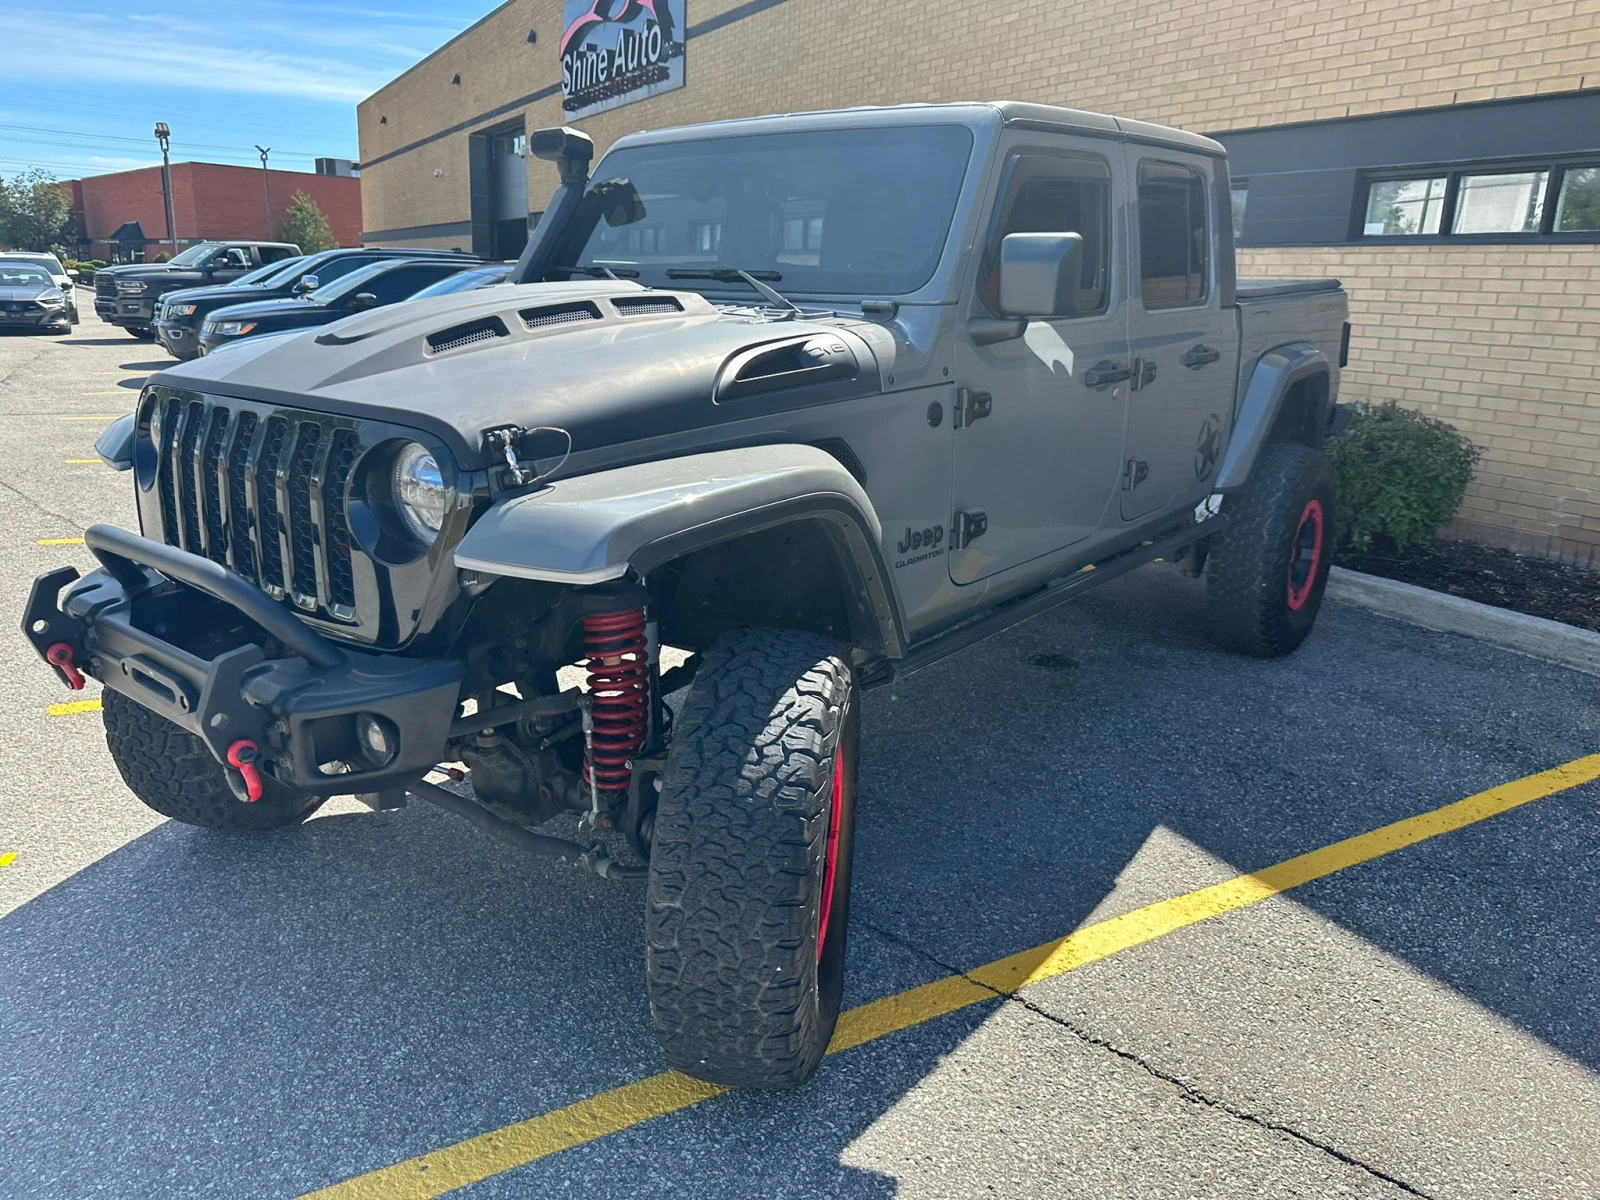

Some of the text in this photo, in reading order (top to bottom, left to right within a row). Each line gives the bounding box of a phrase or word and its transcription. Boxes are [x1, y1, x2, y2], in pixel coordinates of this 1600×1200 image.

[562, 43, 608, 96] Shine
[612, 21, 661, 77] Auto
[897, 525, 943, 554] Jeep
[895, 549, 944, 569] GLADIATOR
